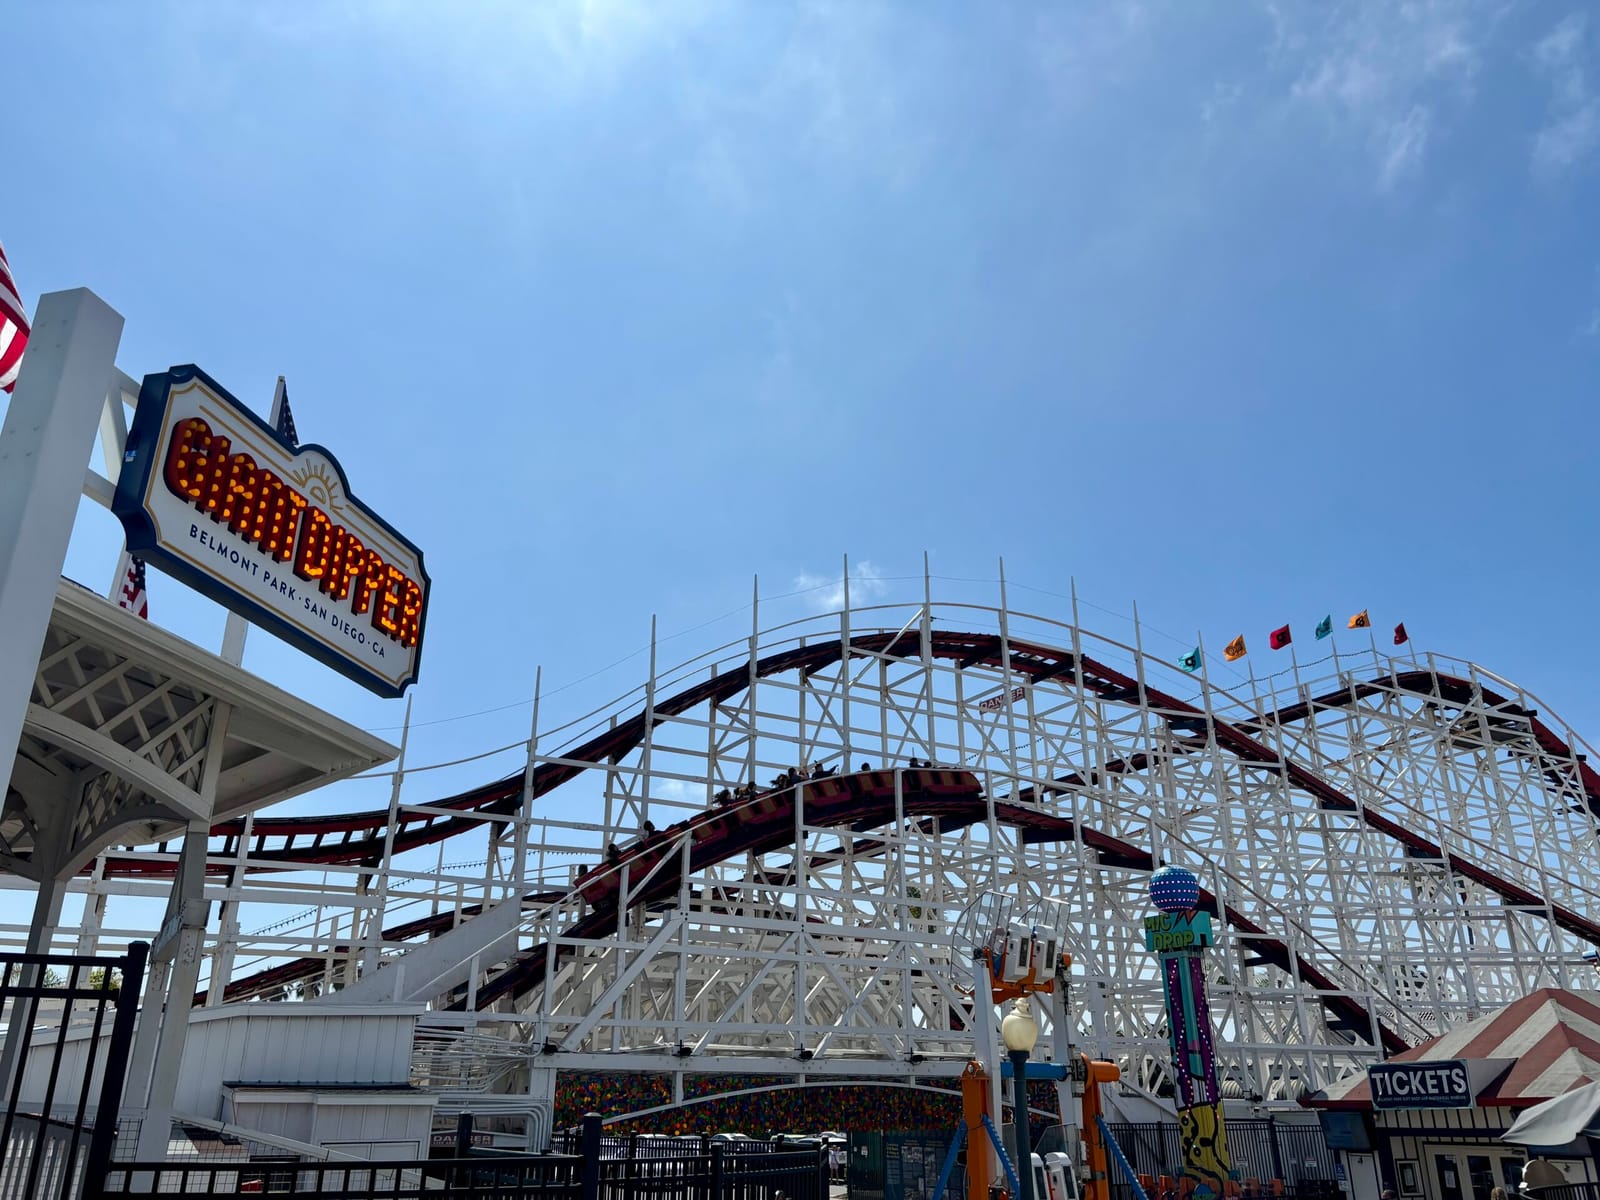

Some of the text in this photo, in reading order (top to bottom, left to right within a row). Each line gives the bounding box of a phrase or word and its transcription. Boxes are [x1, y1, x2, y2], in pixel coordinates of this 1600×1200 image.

[163, 417, 423, 648] GIANT DIPPER
[189, 523, 385, 658] BELMONT PARK SAN DIEGO CA
[980, 688, 1024, 712] DANER
[1144, 913, 1171, 932] MIC
[1153, 930, 1195, 951] DROP
[1371, 1068, 1467, 1096] TICKETS
